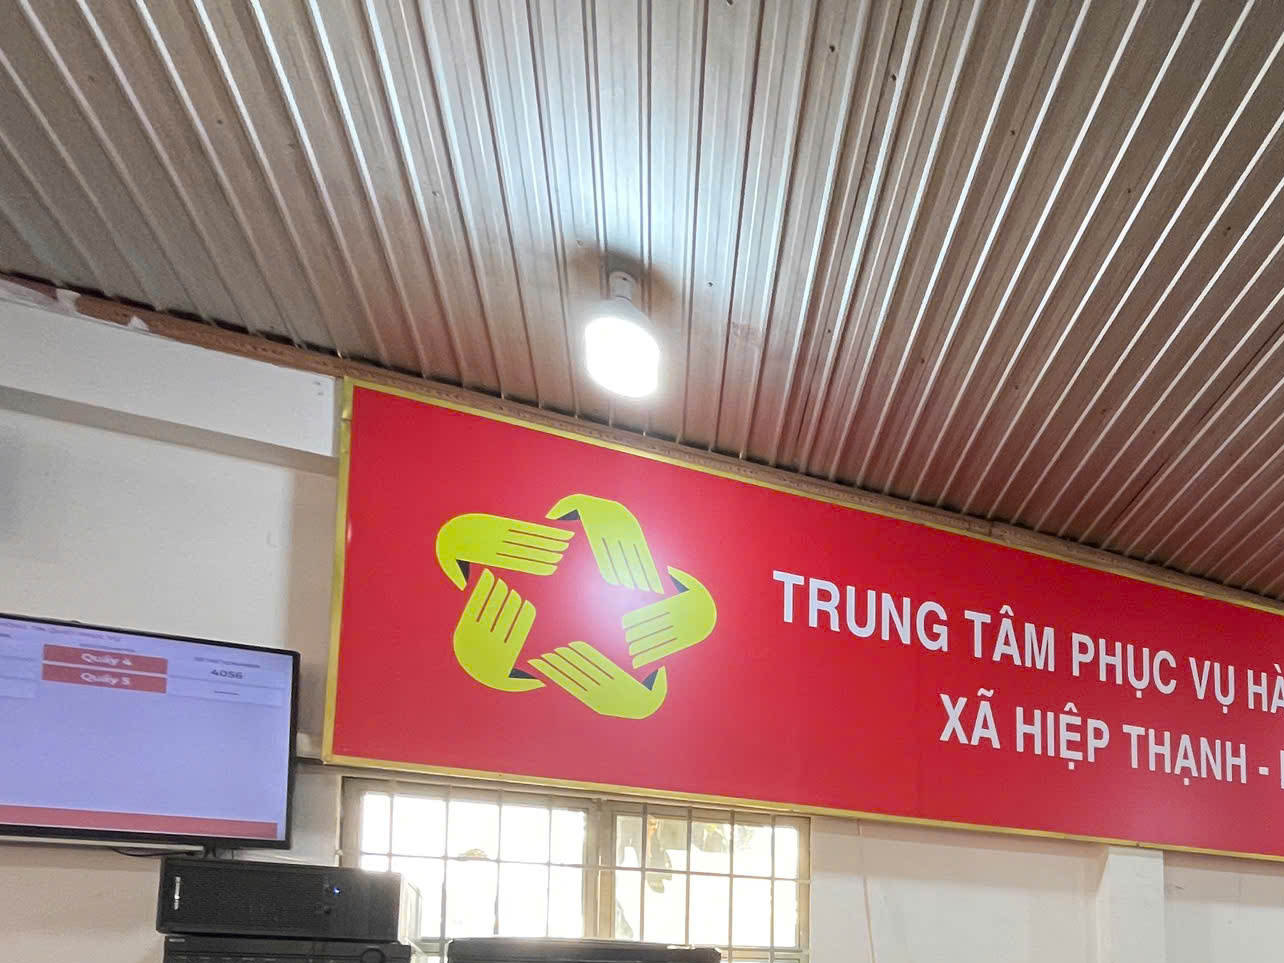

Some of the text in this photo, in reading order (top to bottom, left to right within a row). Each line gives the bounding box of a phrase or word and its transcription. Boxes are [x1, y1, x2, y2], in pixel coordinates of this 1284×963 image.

[772, 570, 949, 652] TRUNG
[964, 604, 1055, 672] TÂM
[1072, 632, 1177, 698] PHỤC
[1188, 656, 1235, 714] VỤ
[939, 688, 1000, 749] XÃ
[1016, 702, 1110, 770] HIỆP
[1122, 723, 1247, 786] THẠNH
[1258, 766, 1269, 776] -
